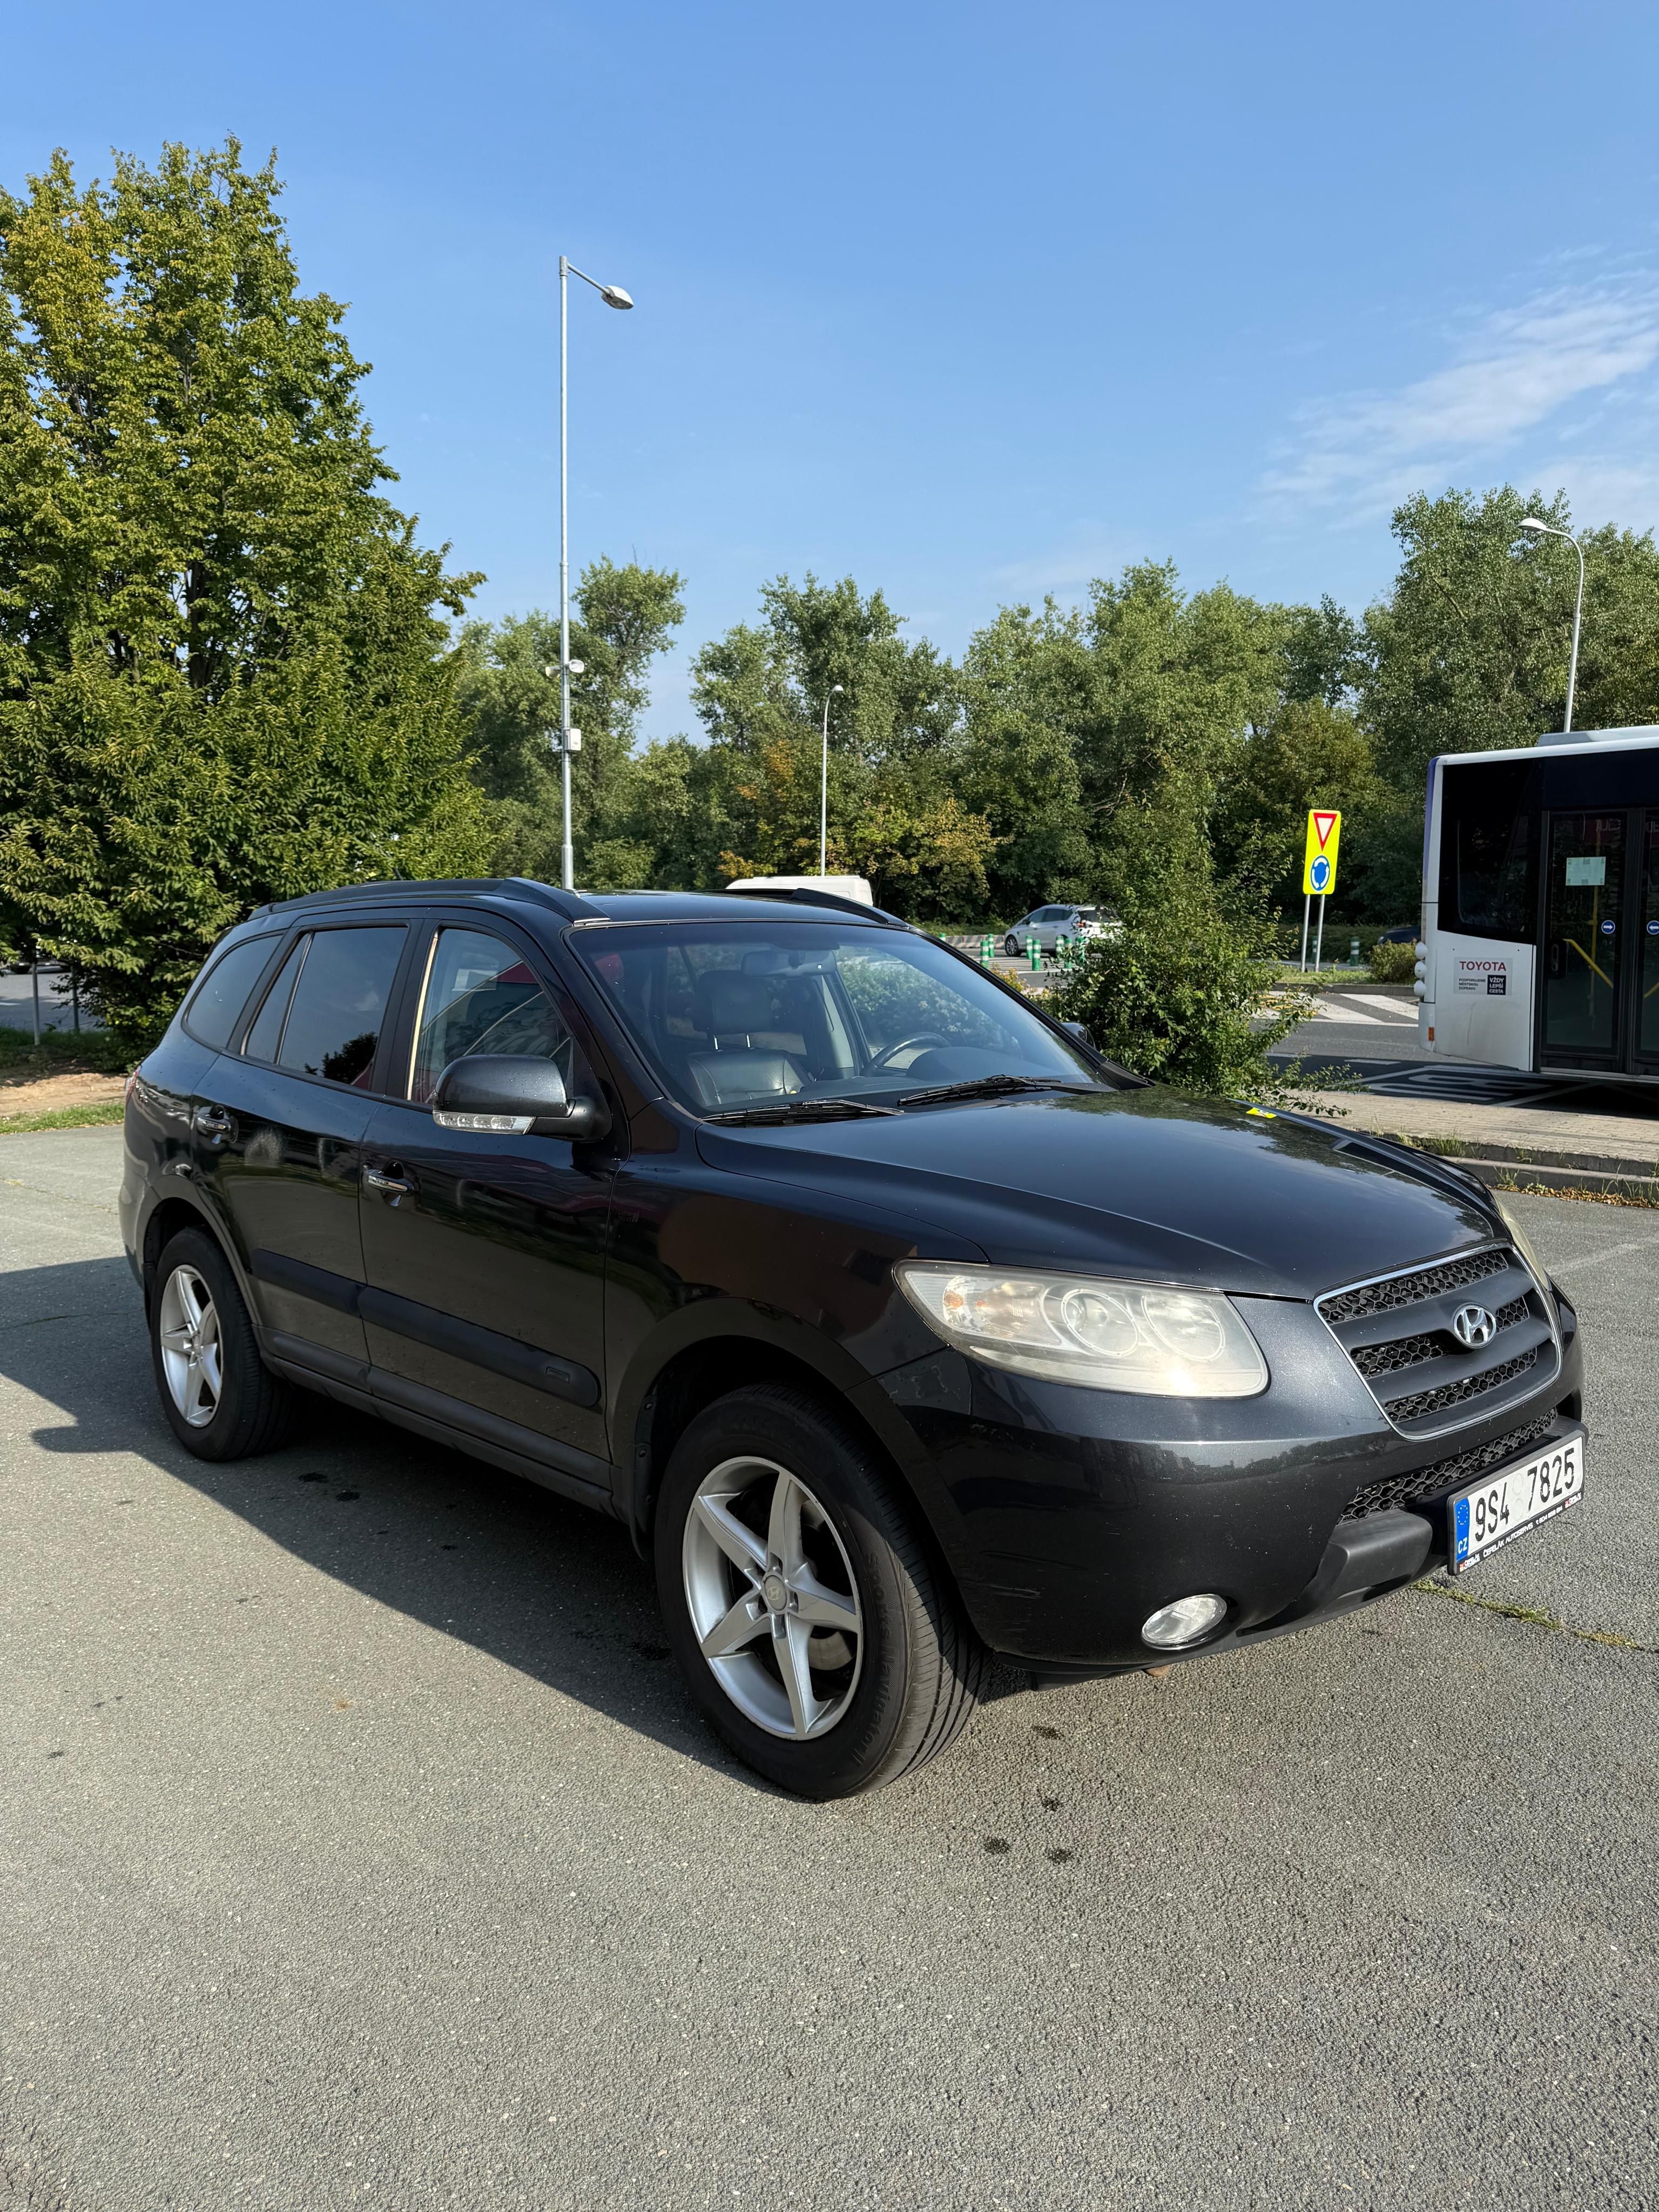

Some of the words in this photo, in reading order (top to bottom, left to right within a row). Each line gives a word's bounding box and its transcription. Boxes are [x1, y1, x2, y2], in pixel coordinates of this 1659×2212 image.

[1459, 961, 1506, 971] TOYOTA
[1475, 1481, 1510, 1542] 9S4
[1527, 1447, 1575, 1513] 7825
[1505, 1522, 1534, 1543] AUTOSERVIS
[1458, 1536, 1468, 1554] CZ
